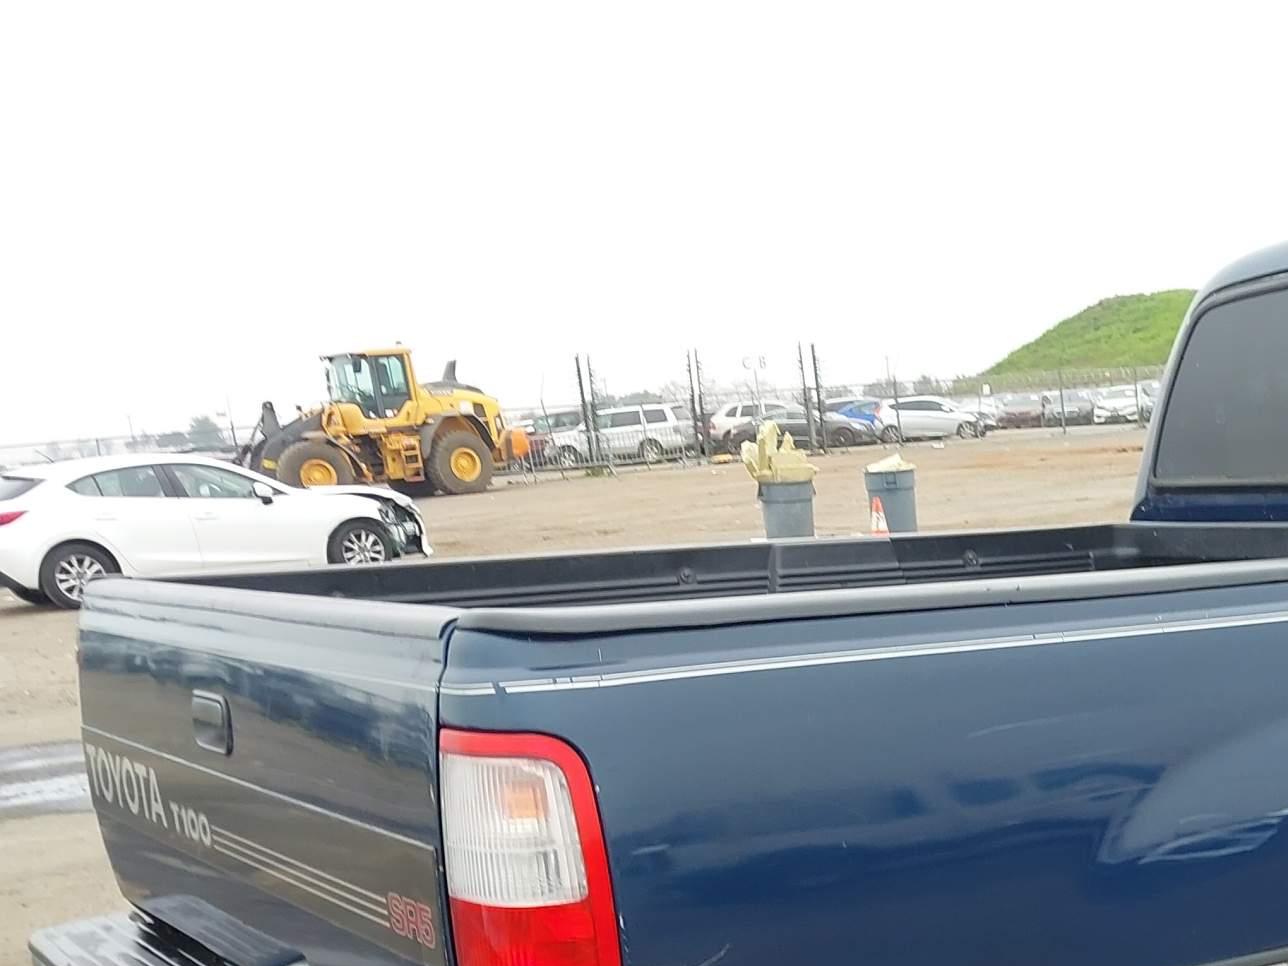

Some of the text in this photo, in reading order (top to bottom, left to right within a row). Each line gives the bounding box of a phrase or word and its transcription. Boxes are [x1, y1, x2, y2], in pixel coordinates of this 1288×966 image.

[85, 742, 211, 846] TOYOTA T100
[388, 891, 436, 949] SR5
